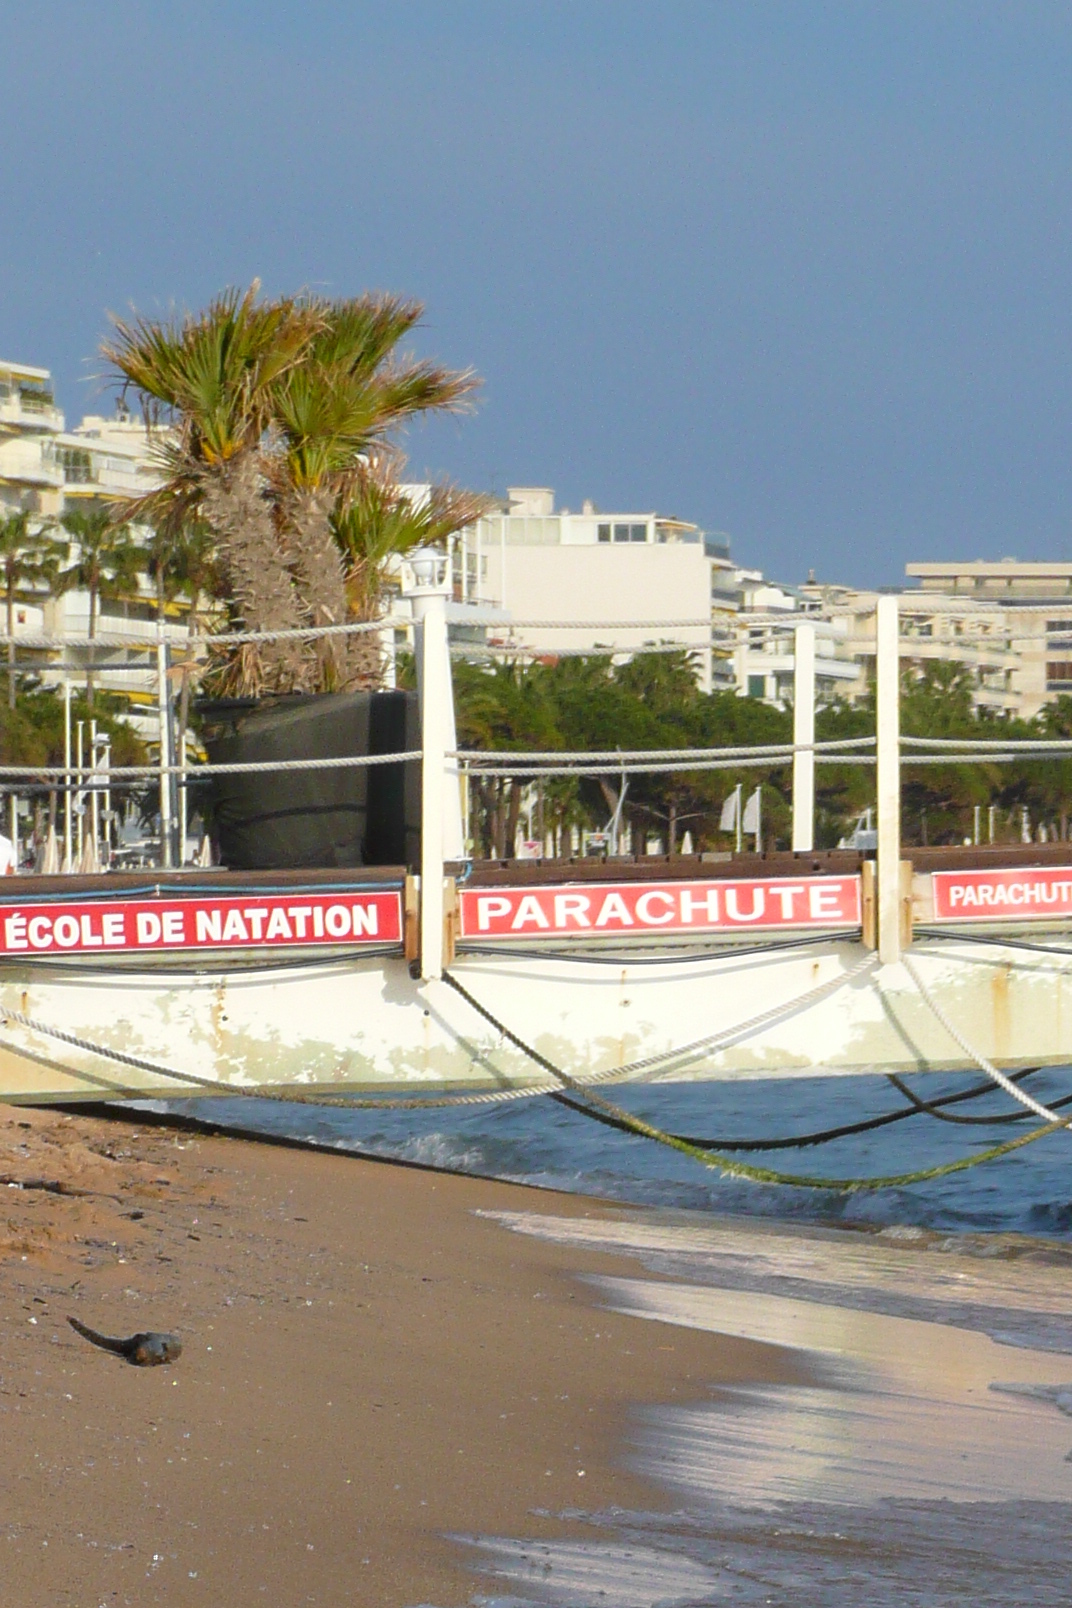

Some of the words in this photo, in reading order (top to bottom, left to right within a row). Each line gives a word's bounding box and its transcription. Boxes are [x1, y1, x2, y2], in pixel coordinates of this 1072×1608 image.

[5, 912, 125, 949] ÉCOLE
[136, 911, 185, 944] DE
[196, 904, 379, 942] NATATION
[477, 885, 844, 930] PARACHUTE
